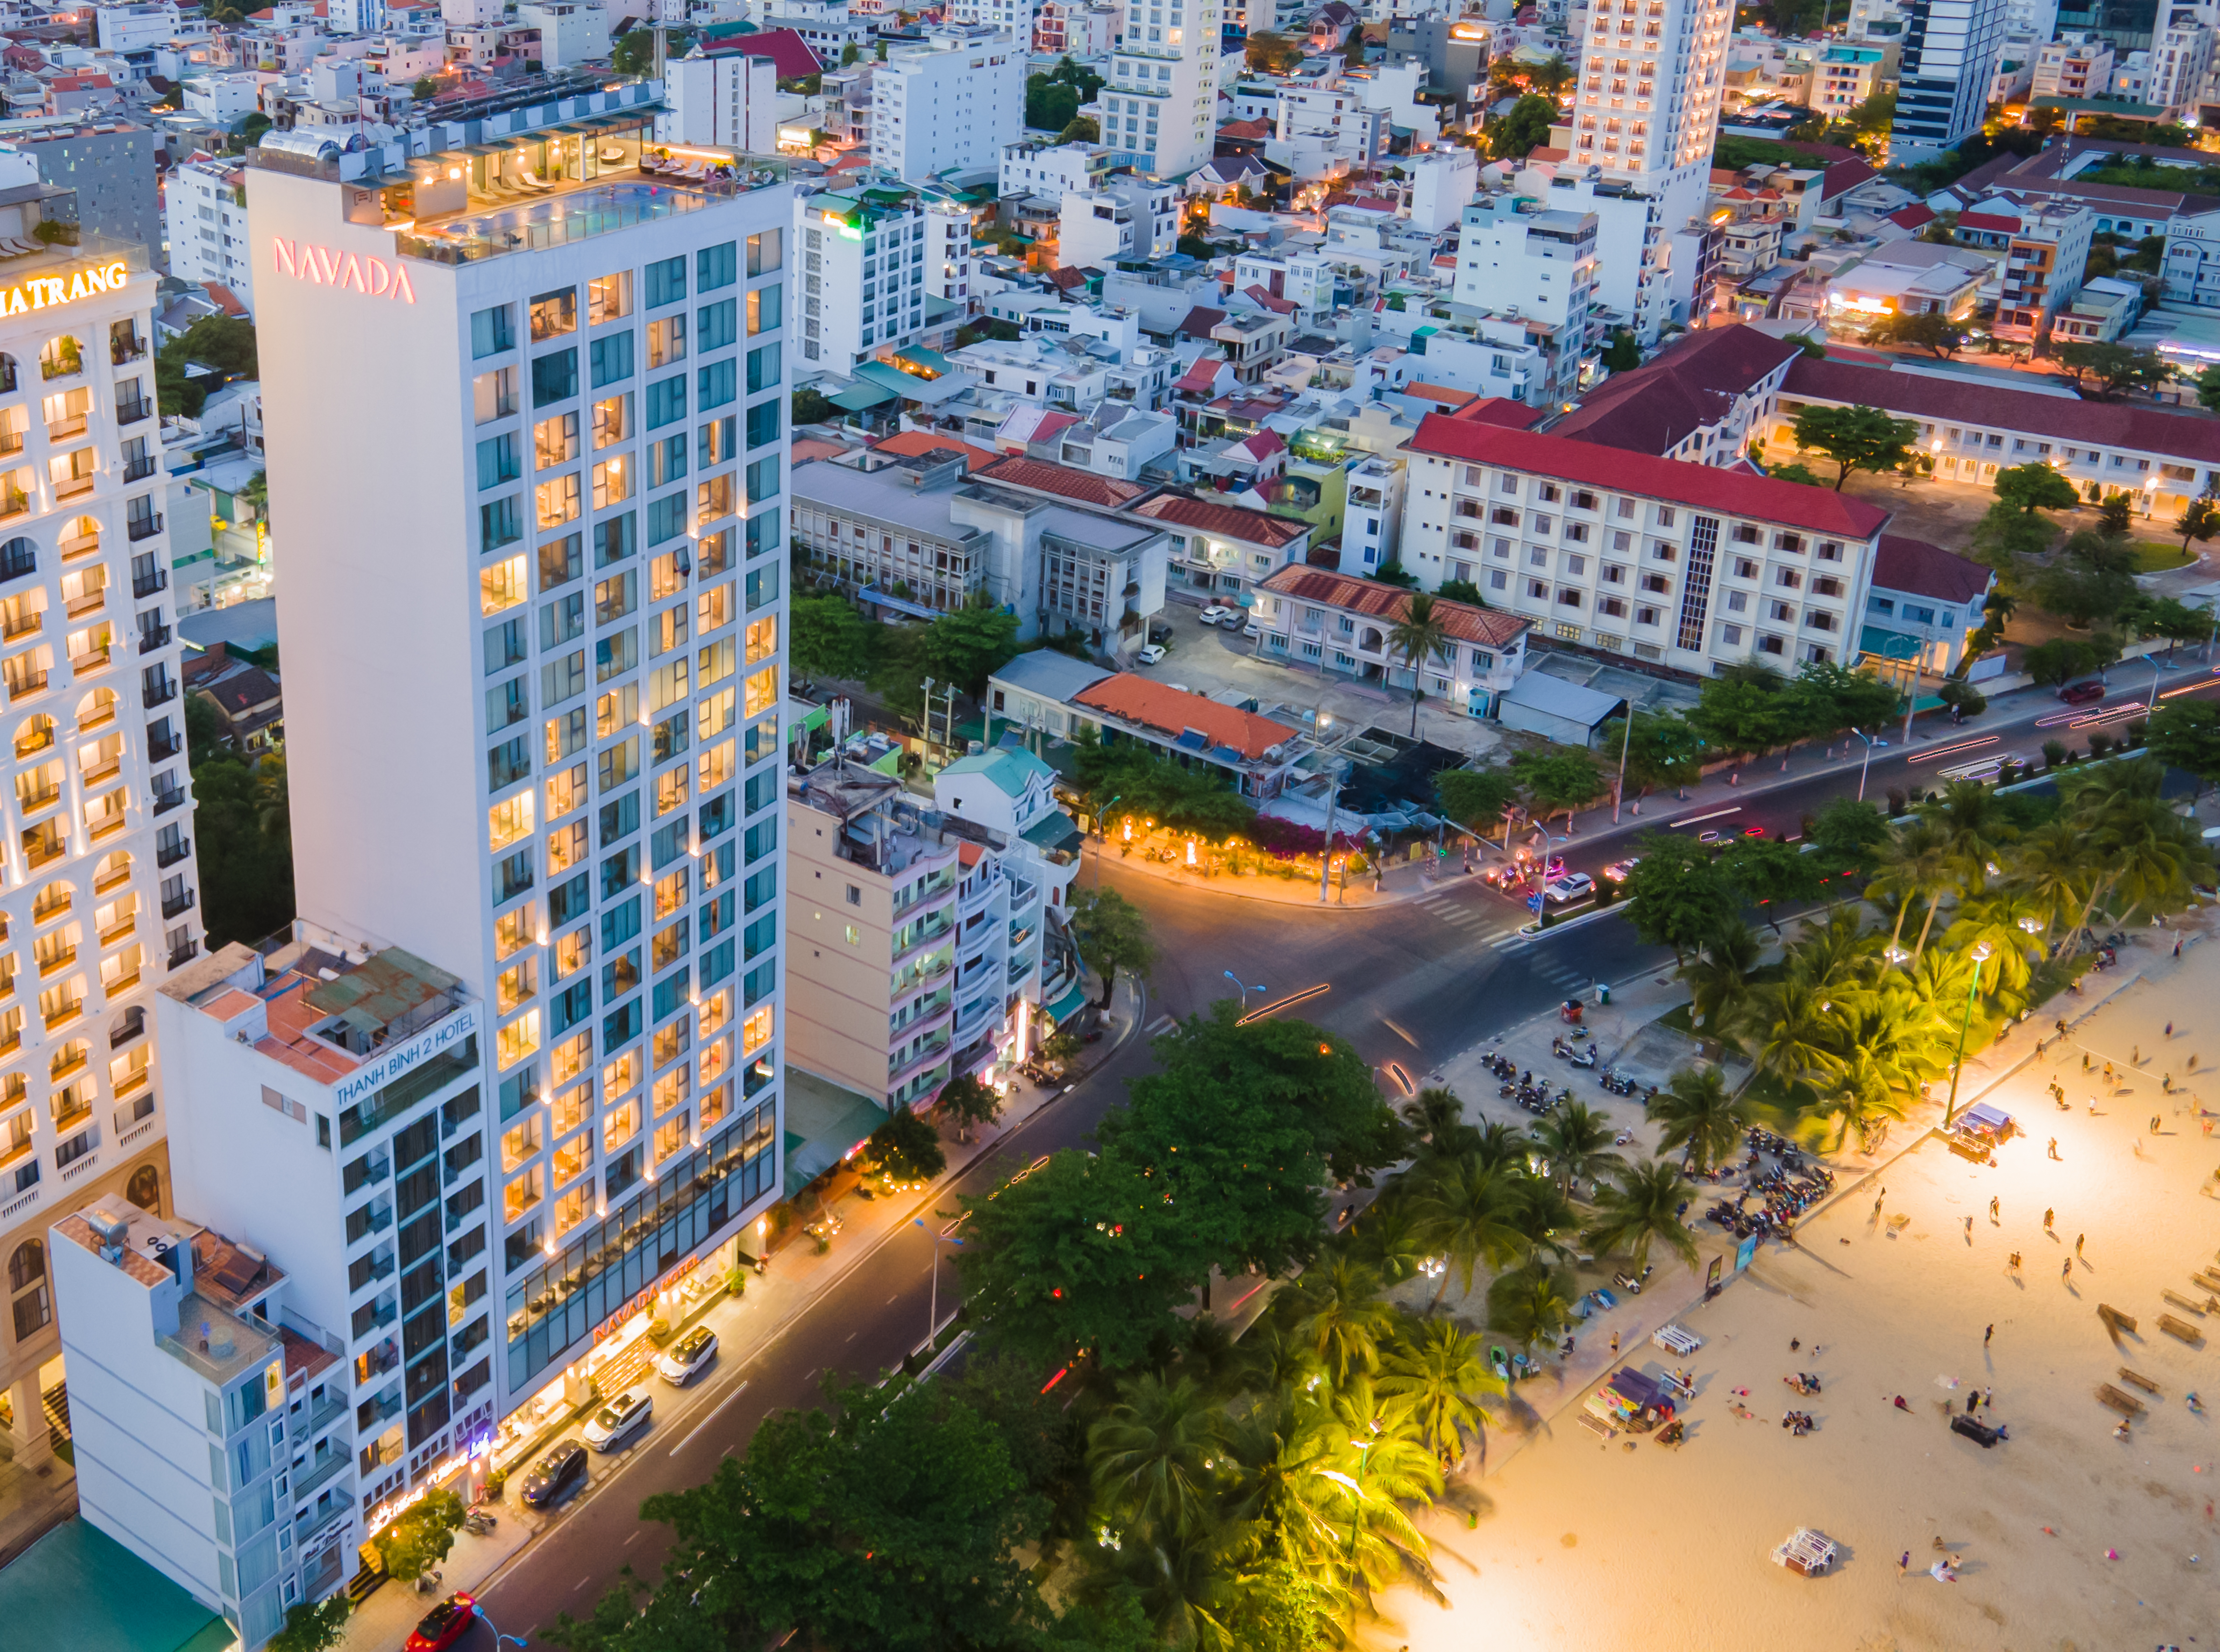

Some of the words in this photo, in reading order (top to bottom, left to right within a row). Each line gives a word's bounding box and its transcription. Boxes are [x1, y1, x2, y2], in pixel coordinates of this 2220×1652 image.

[27, 263, 127, 309] TRANG
[273, 237, 415, 304] NAVADA
[338, 1065, 384, 1105] THANH
[389, 1044, 419, 1075] BÌNH
[423, 1038, 432, 1055] 2
[435, 1013, 476, 1047] HOTEL
[593, 1283, 659, 1344] NAVADA
[660, 1253, 700, 1292] HOTEL
